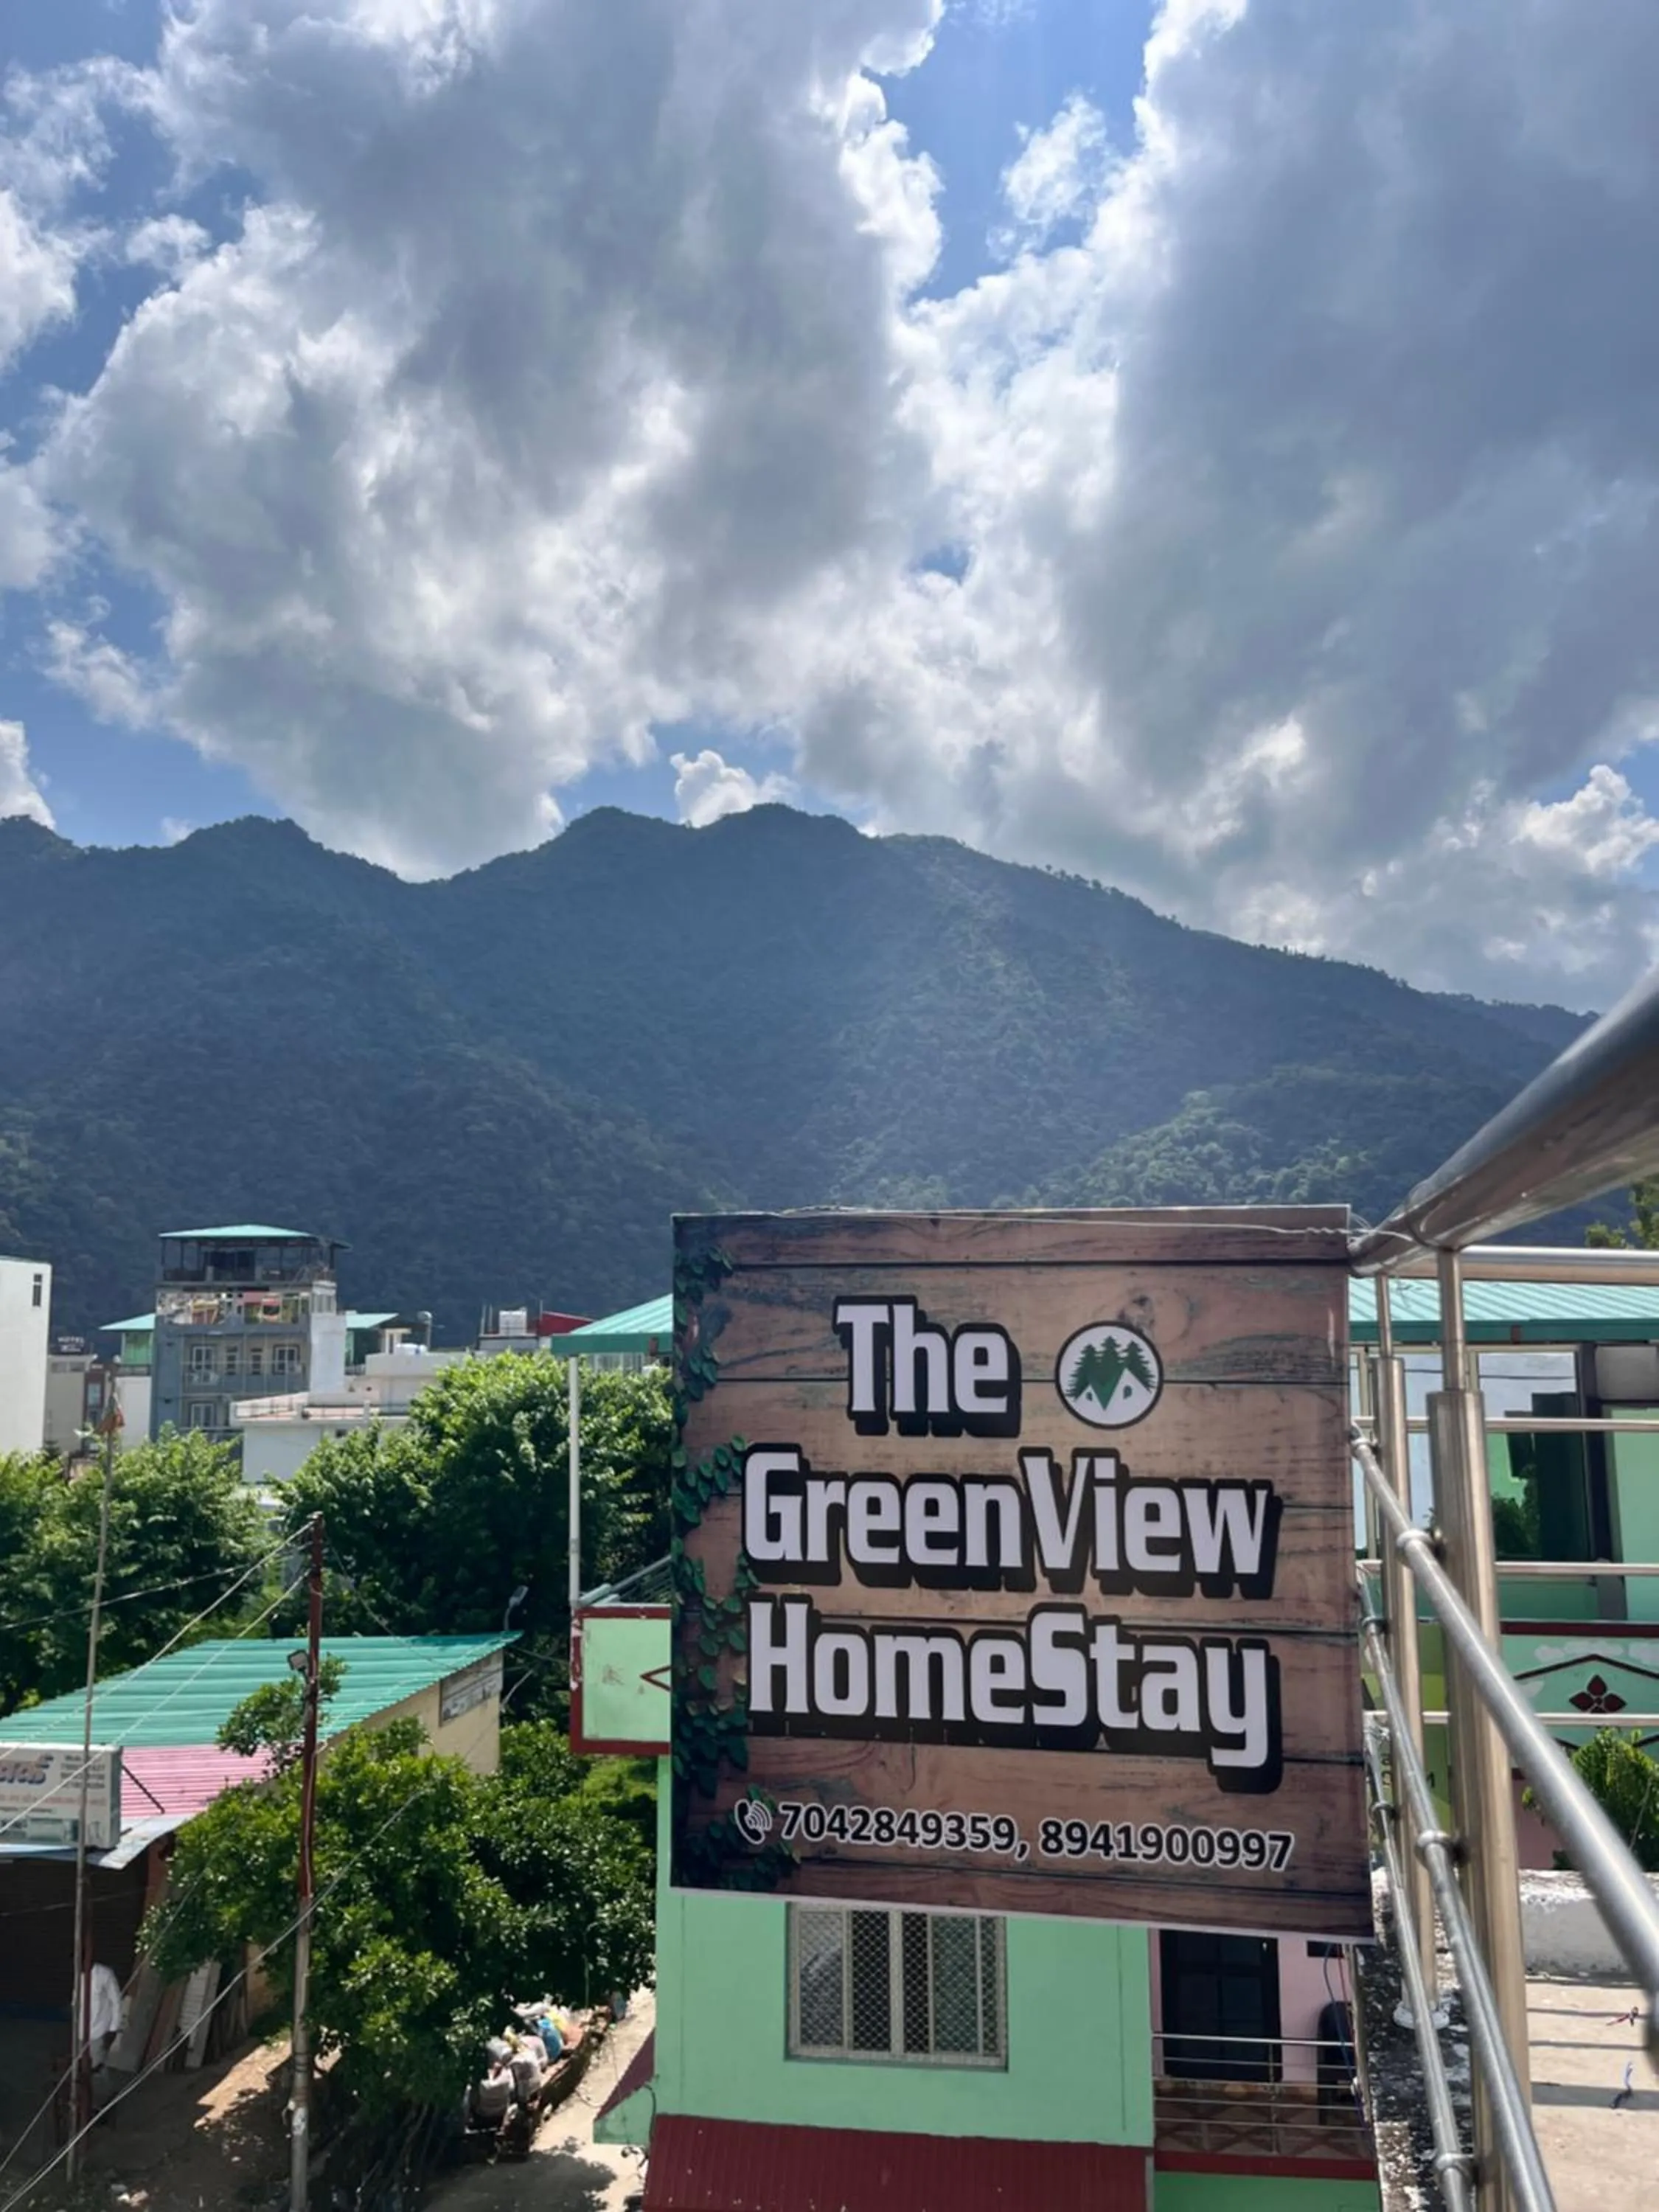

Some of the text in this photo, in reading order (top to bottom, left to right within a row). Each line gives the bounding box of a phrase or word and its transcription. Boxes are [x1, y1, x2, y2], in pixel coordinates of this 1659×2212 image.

[838, 1304, 1009, 1413] The
[745, 1451, 1269, 1575] GreenView
[749, 1601, 1269, 1768] HomeStay
[779, 1804, 1295, 1871] 7042849359, 8941900997
